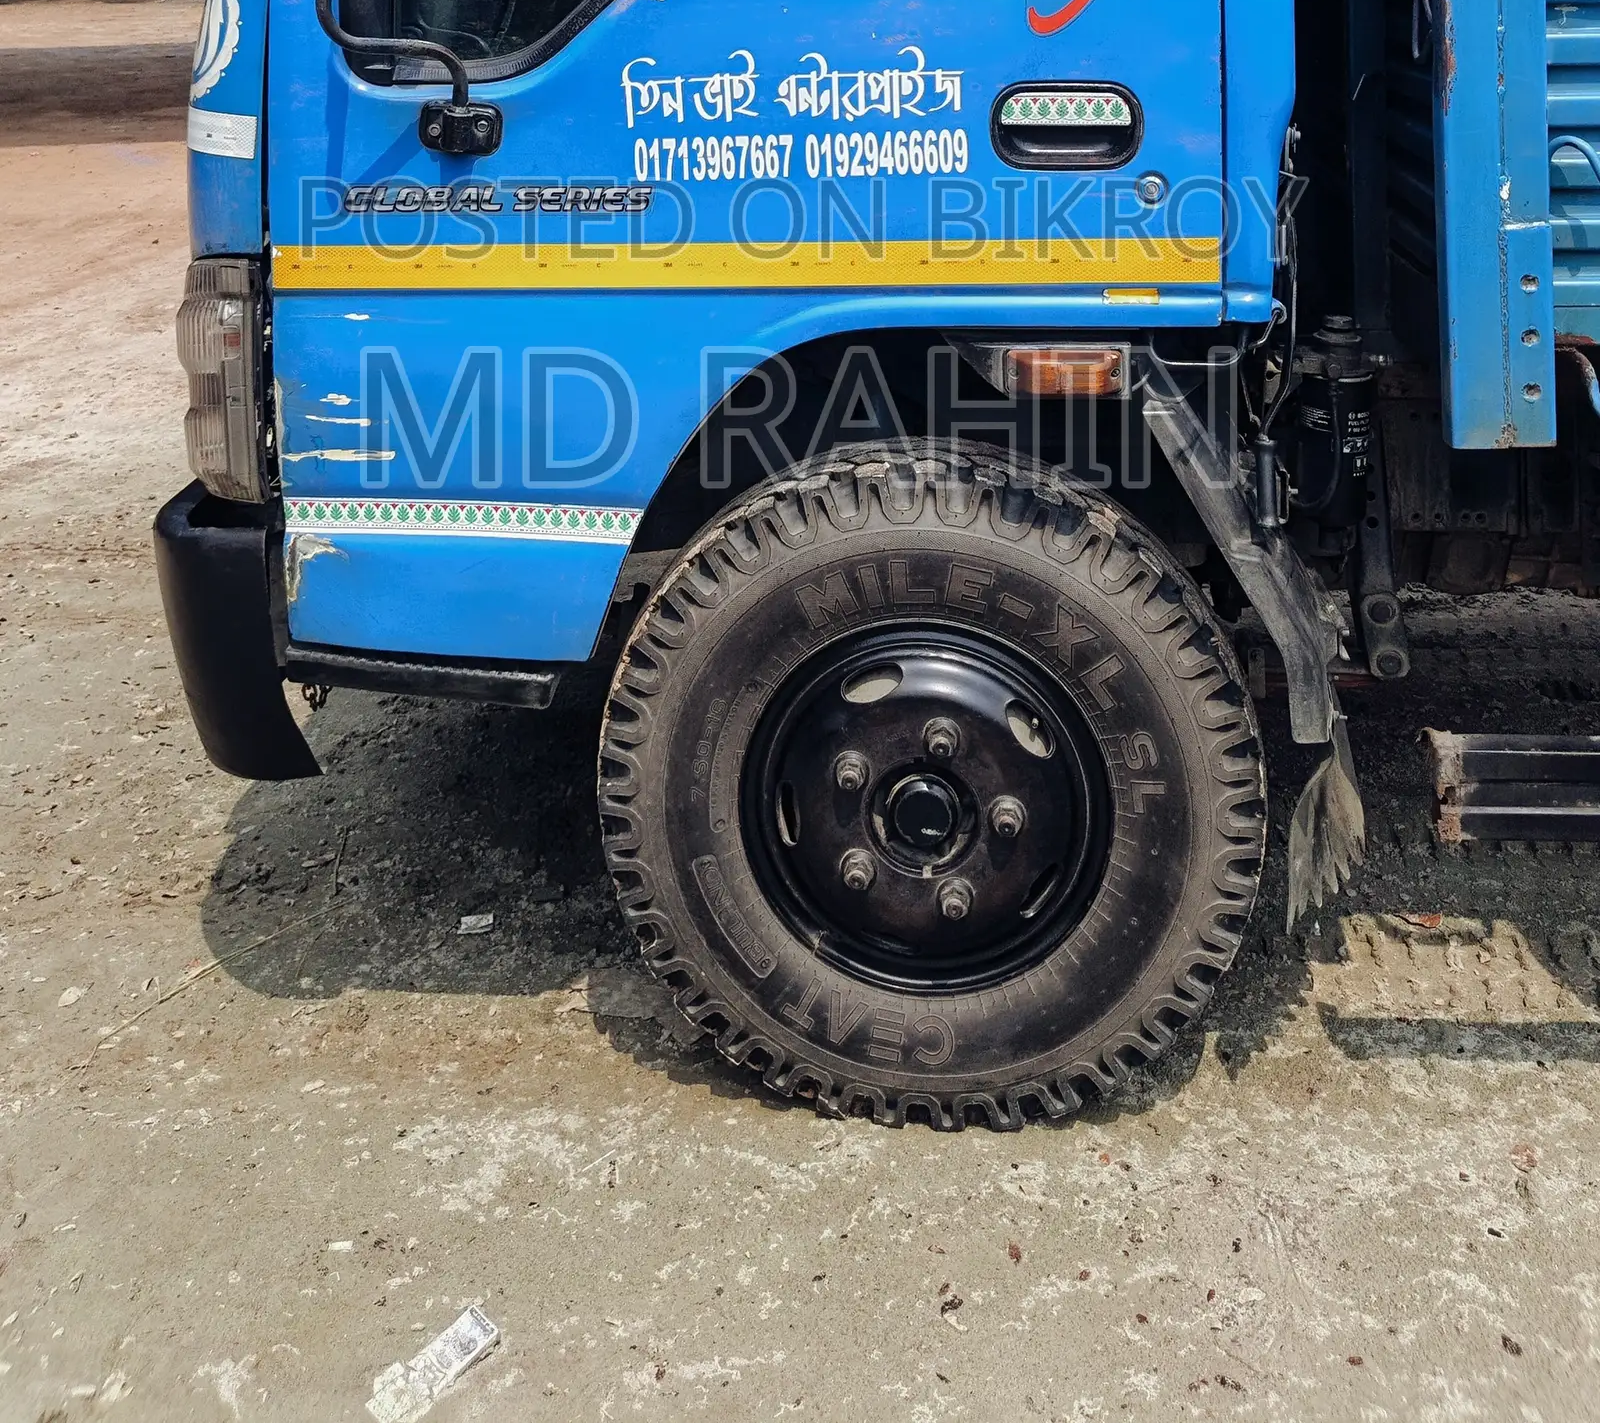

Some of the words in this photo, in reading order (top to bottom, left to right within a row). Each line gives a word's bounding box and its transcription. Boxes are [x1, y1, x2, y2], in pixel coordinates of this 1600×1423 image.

[620, 57, 685, 129] তিন
[688, 49, 760, 123] ভাই
[773, 45, 965, 122] এন্টারপ্রাইজ
[633, 134, 794, 182] 01713967667
[804, 128, 969, 179] 01929466609
[345, 185, 504, 213] GLOBAL
[512, 185, 652, 213] SERIES
[795, 559, 1127, 712] MILE-XL
[1119, 730, 1168, 815] SL
[780, 977, 955, 1066] CEAT
